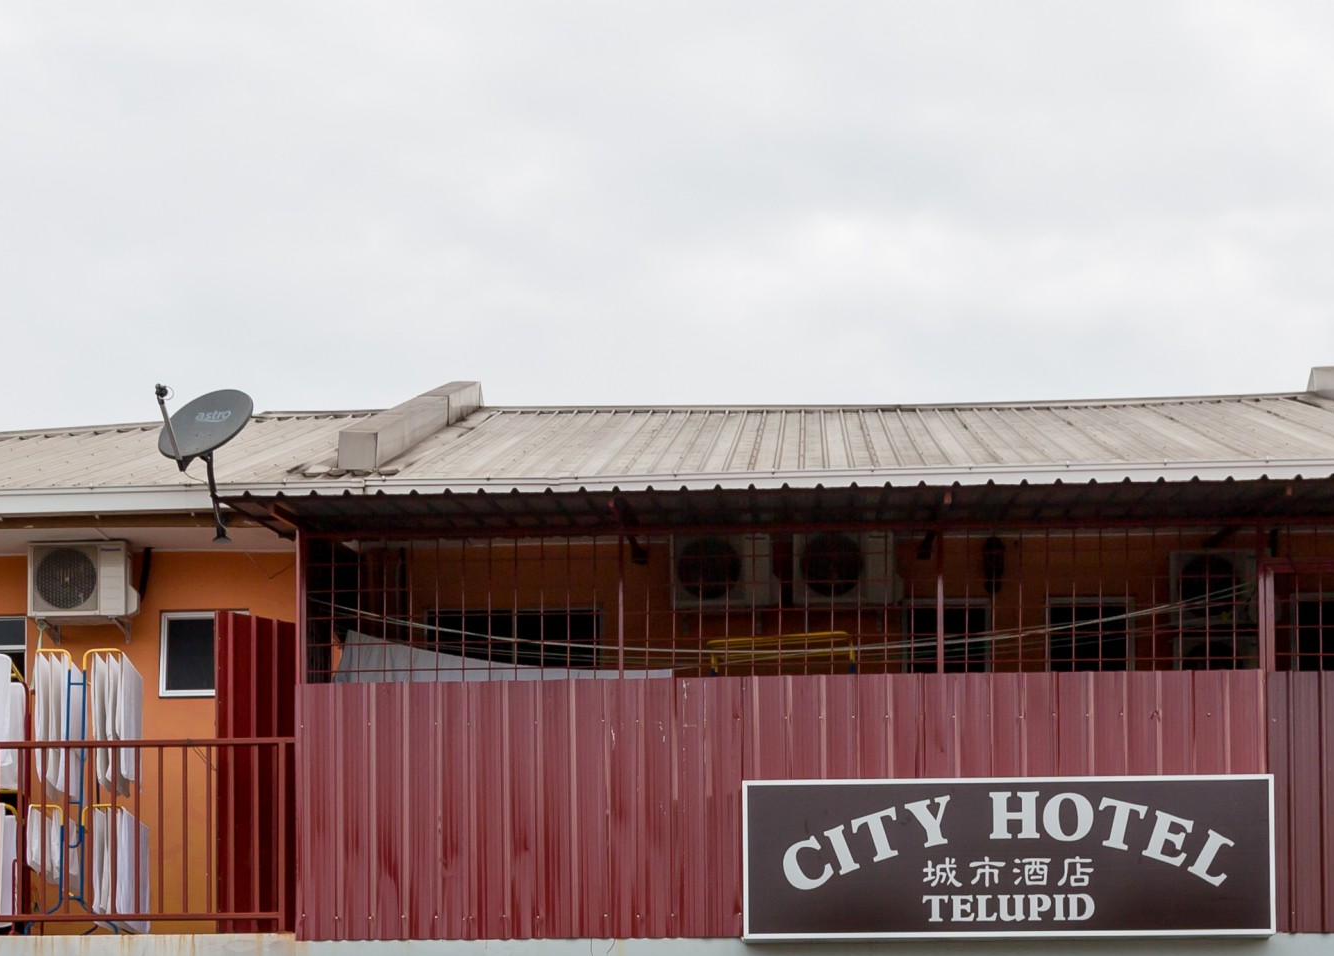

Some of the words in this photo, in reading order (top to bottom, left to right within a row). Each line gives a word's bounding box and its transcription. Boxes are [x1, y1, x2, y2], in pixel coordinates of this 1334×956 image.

[195, 410, 232, 422] astro
[782, 794, 951, 890] CITY
[988, 791, 1236, 887] HOTEL
[923, 856, 1095, 888] 城市酒店
[922, 893, 1096, 923] TELUPID
